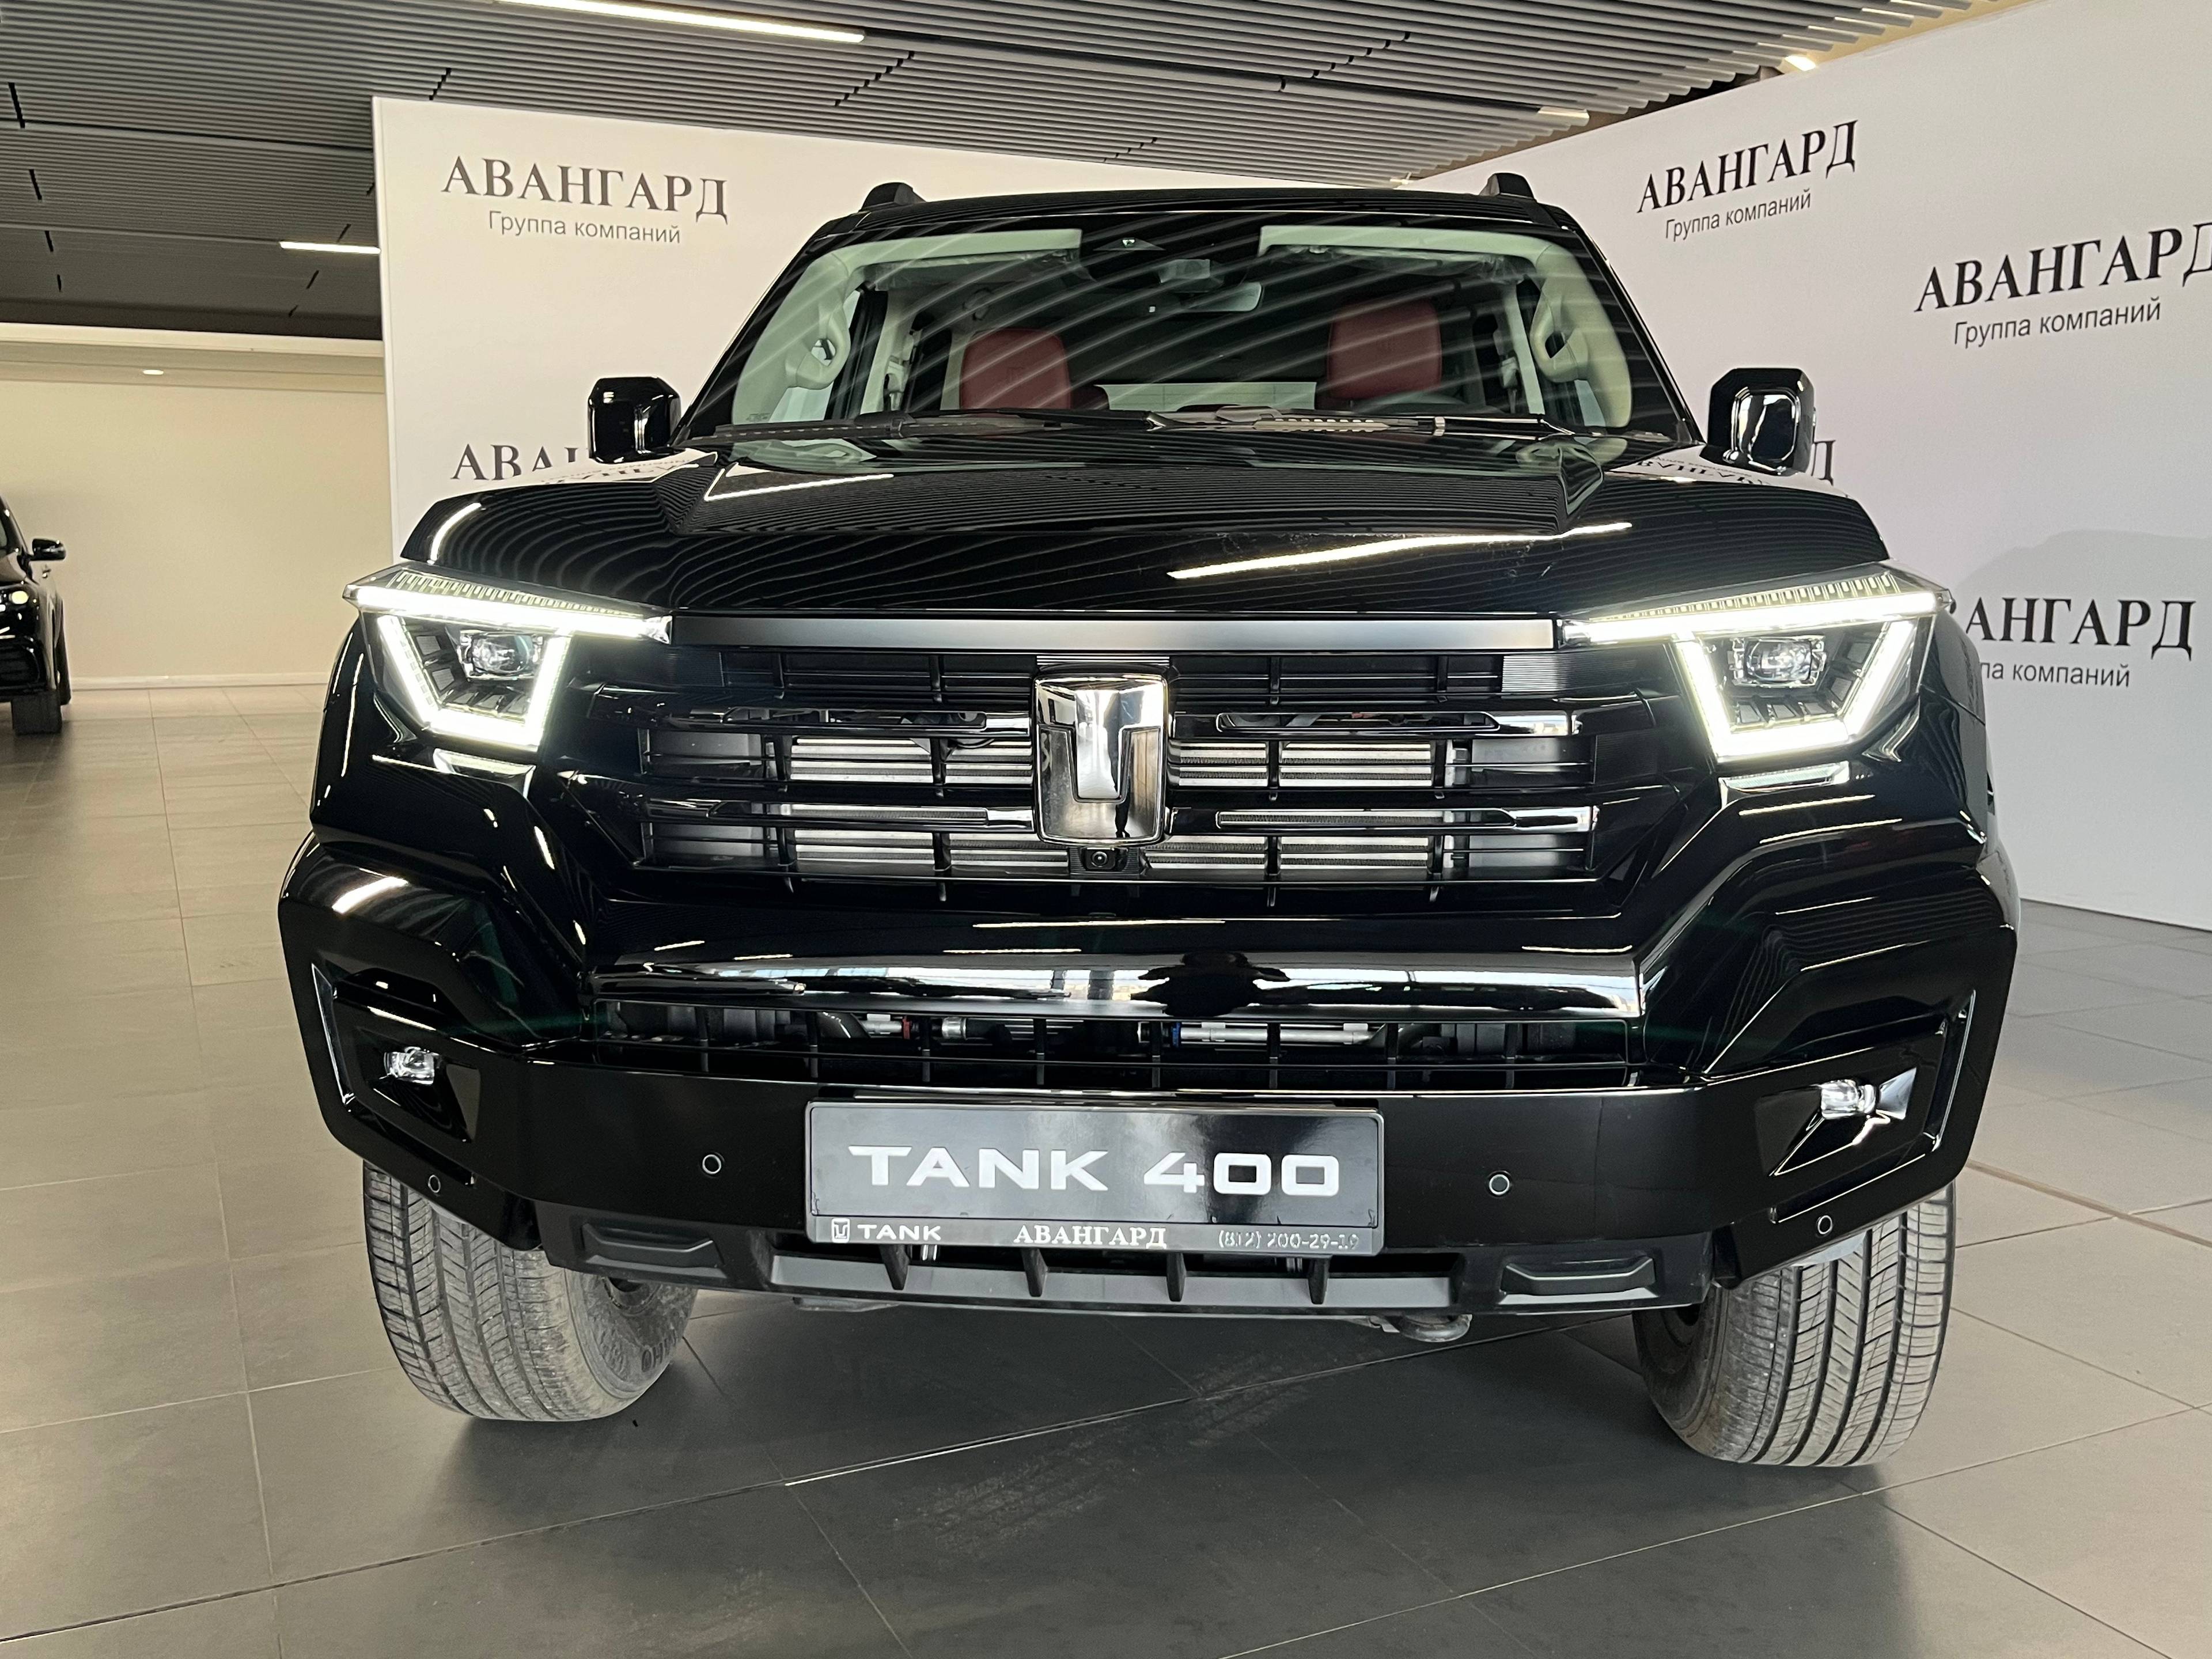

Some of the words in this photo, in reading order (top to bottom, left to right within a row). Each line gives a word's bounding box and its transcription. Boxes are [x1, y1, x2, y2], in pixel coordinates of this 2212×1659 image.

[1637, 120, 1858, 213] АВАНГАРД
[441, 156, 728, 225] АВАНГАРД
[489, 210, 566, 237] Группа
[575, 222, 681, 244] компаний
[1665, 213, 1721, 243] Группа
[1725, 188, 1811, 226] компаний
[1953, 318, 2032, 350] Группа
[2039, 296, 2161, 335] компаний
[450, 443, 578, 481] АВА
[1965, 597, 2196, 661] АНГАРД
[1980, 662, 2004, 680] па
[2012, 663, 2131, 688] компаний
[848, 1145, 1109, 1191] TANK
[1143, 1152, 1340, 1196] 400
[857, 1224, 941, 1241] TANK
[1013, 1225, 1167, 1249] АВАНГАРД
[1218, 1229, 1262, 1249] (812)
